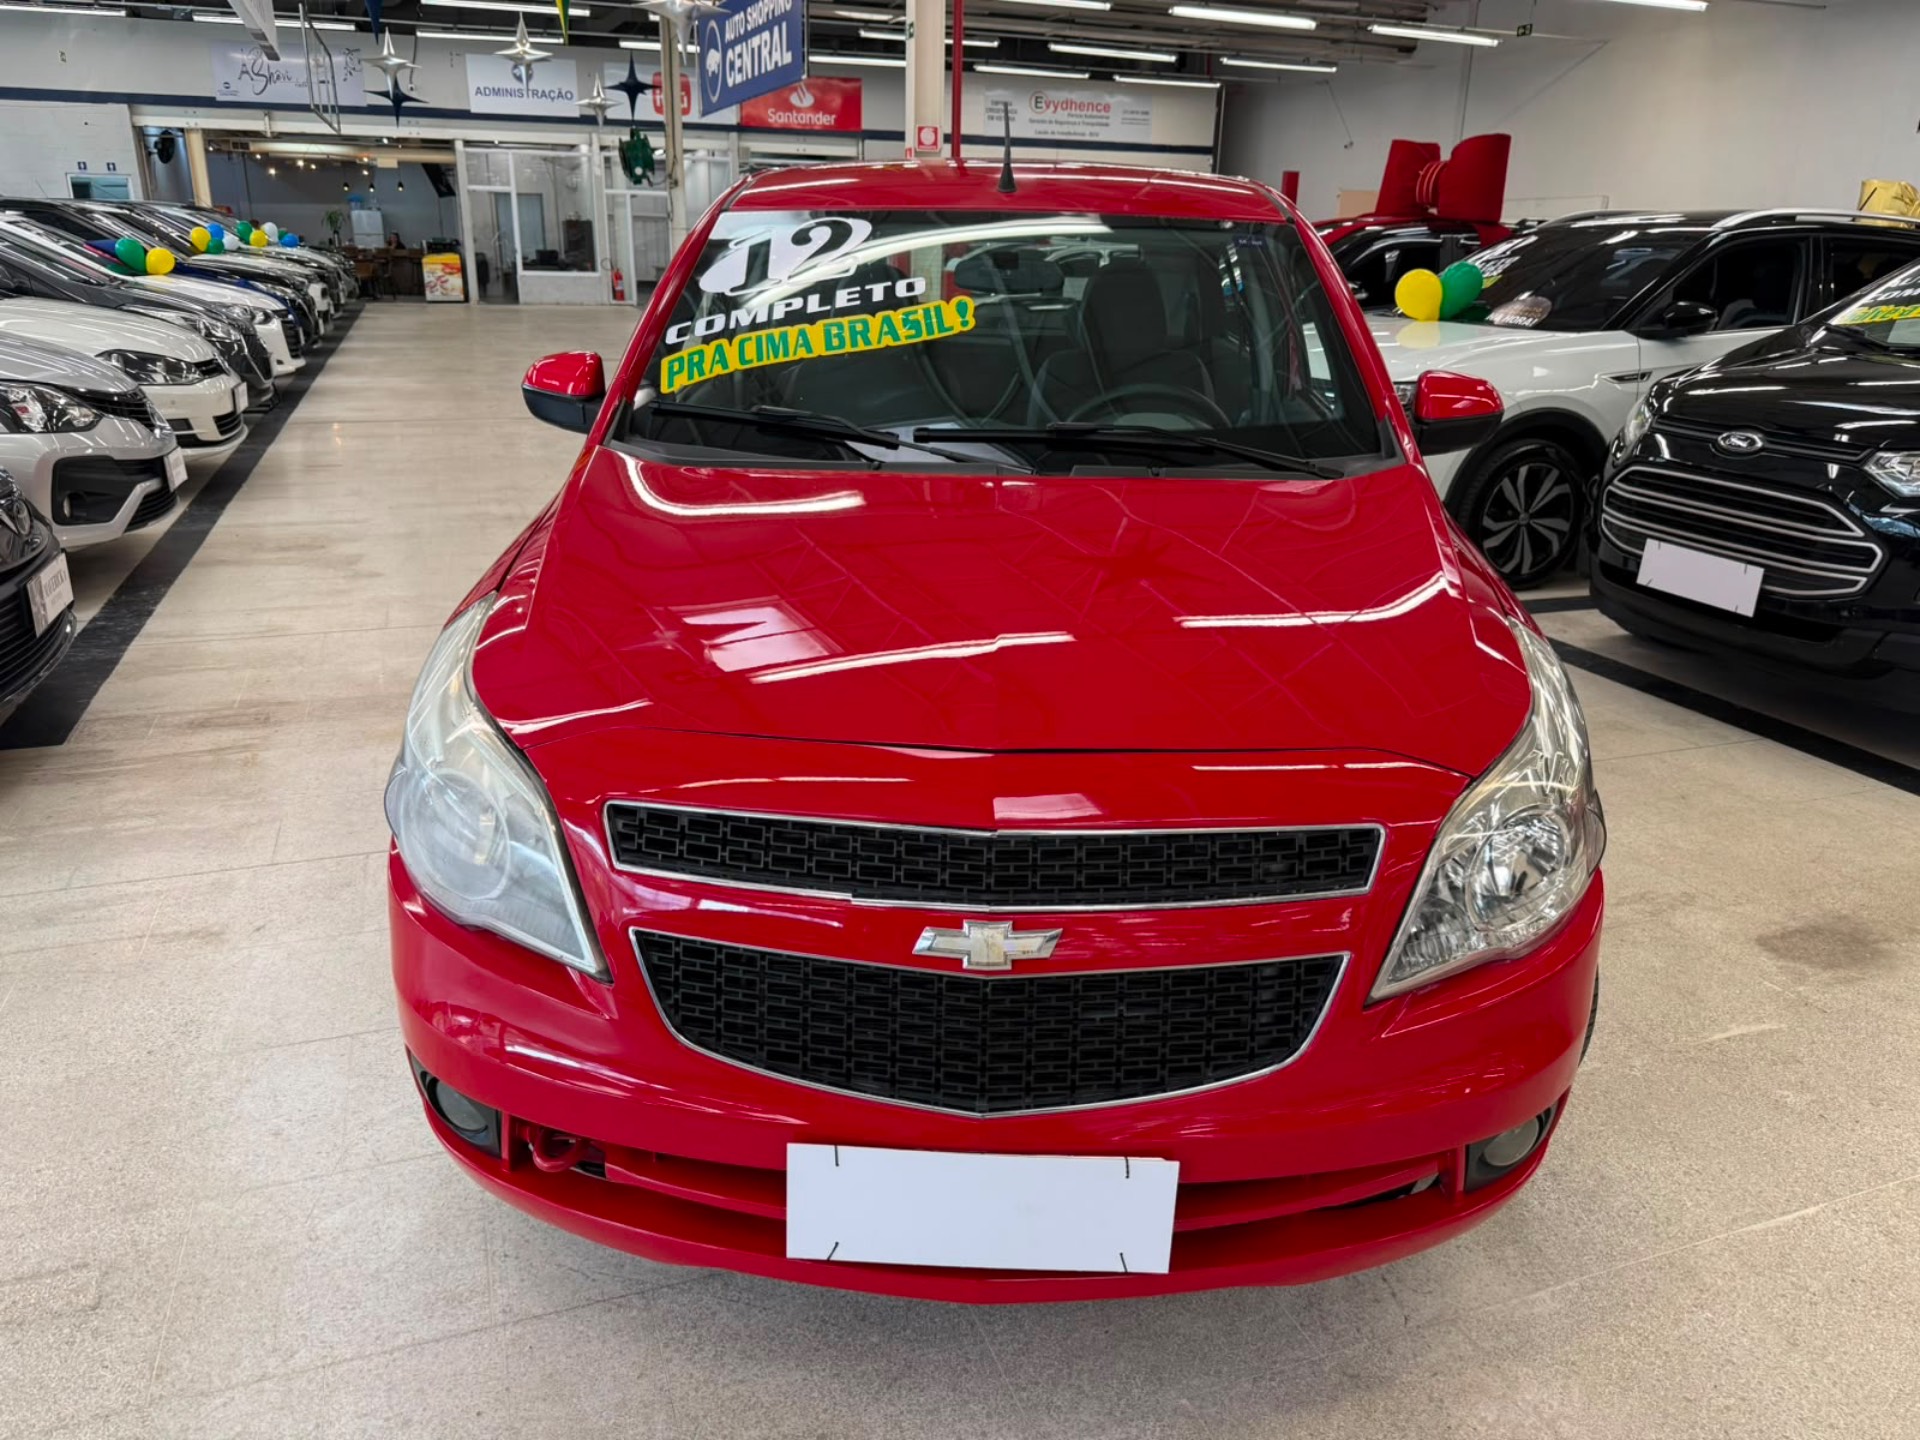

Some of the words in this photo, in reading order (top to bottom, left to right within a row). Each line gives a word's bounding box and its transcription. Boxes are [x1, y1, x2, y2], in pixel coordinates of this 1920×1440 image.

[725, 11, 745, 44] AUTO
[725, 21, 792, 88] CENTRAL
[474, 86, 574, 102] ADMINISTRAÇÃO
[768, 109, 836, 126] Santander
[1033, 95, 1112, 114] Evydhence
[699, 216, 872, 296] 12
[665, 277, 926, 345] COMPLETO
[666, 340, 729, 391] PRA
[738, 327, 814, 367] CIMA
